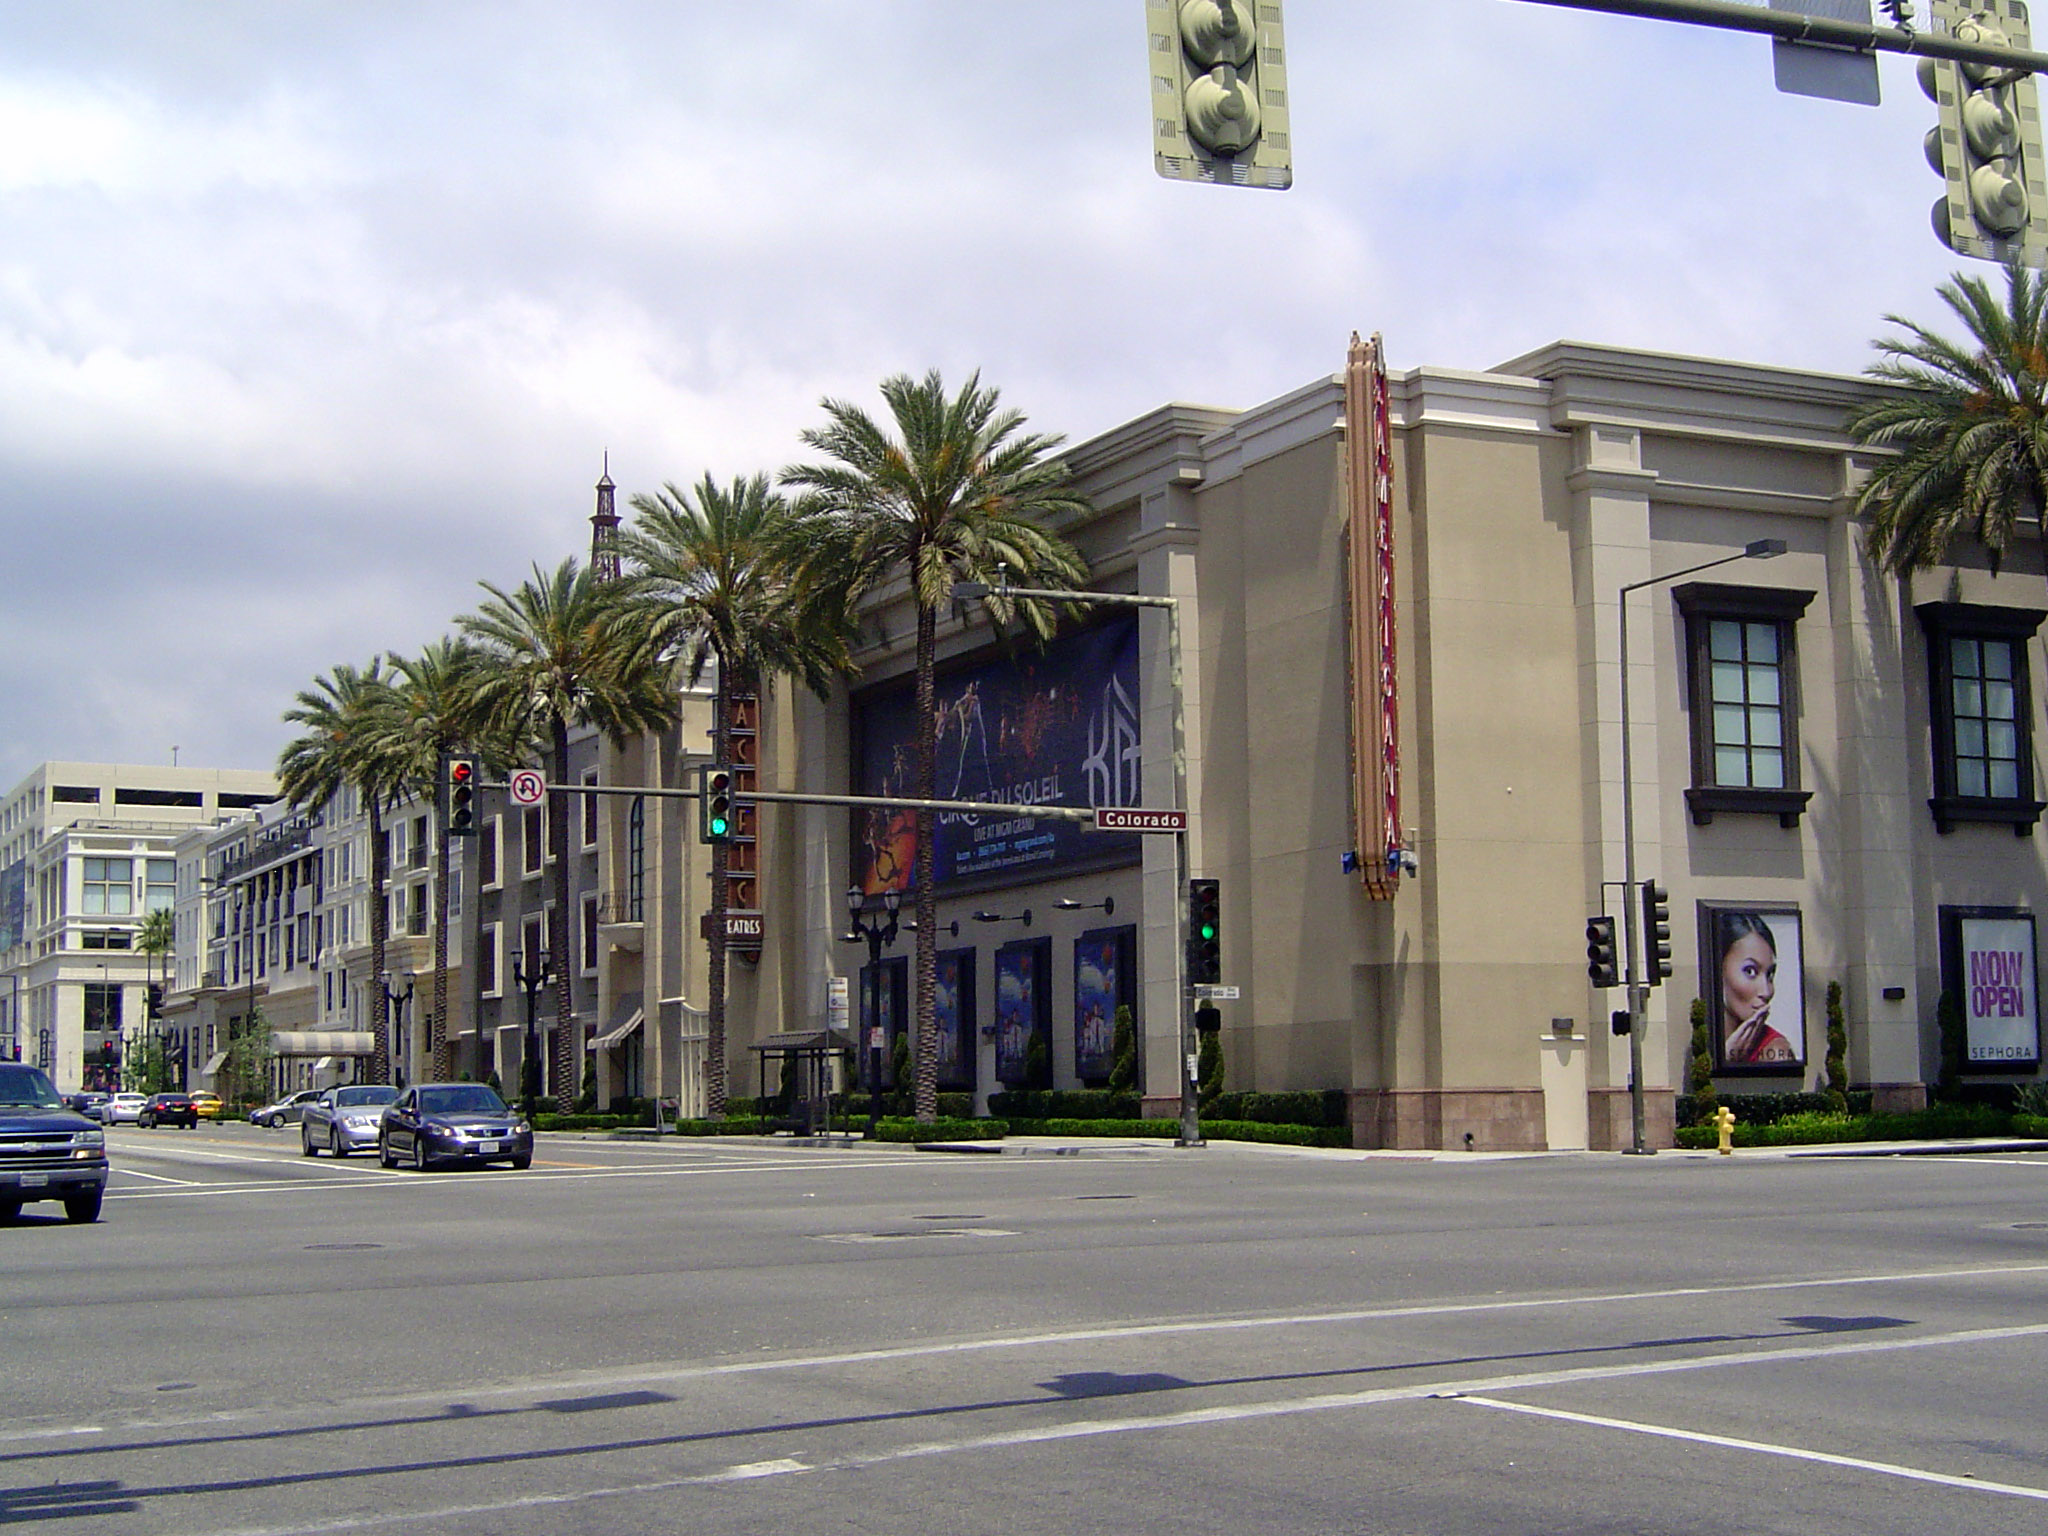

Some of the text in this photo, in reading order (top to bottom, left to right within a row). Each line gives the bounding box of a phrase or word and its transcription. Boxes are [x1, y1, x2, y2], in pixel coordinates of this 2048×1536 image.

[1374, 420, 1397, 846] AMERICANA
[735, 702, 747, 903] ACIFIC
[1014, 775, 1063, 805] SOLEIL
[974, 817, 1035, 842] LIVE AT MGM GRAND
[1106, 812, 1179, 827] Colorado
[727, 919, 760, 934] EATRES
[1970, 950, 2024, 986] NOW
[1972, 986, 2025, 1017] OPEN
[1972, 1047, 2032, 1059] SEPHORA
